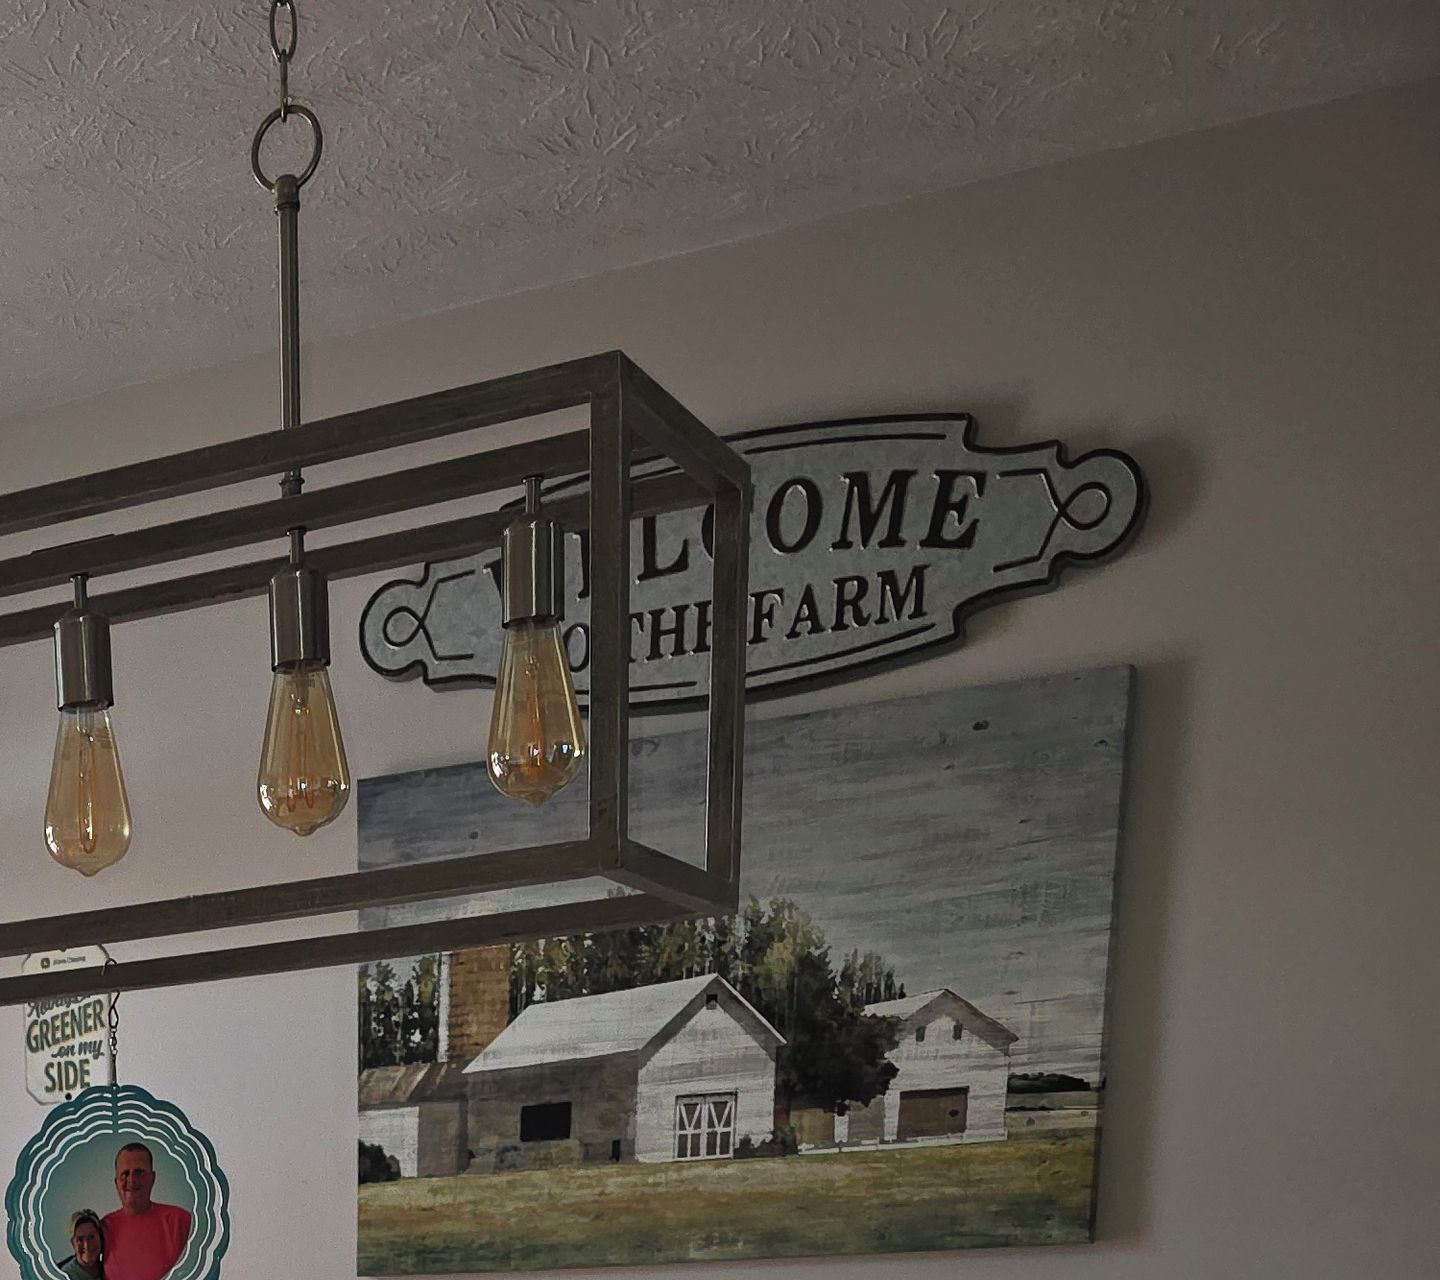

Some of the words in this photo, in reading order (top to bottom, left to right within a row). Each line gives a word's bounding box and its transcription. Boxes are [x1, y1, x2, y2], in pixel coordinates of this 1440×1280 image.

[484, 469, 987, 602] LOME
[747, 564, 931, 645] FARM
[26, 999, 106, 1053] GREENER
[51, 1045, 76, 1058] on
[78, 1039, 105, 1060] my
[44, 1058, 91, 1093] SIDE
